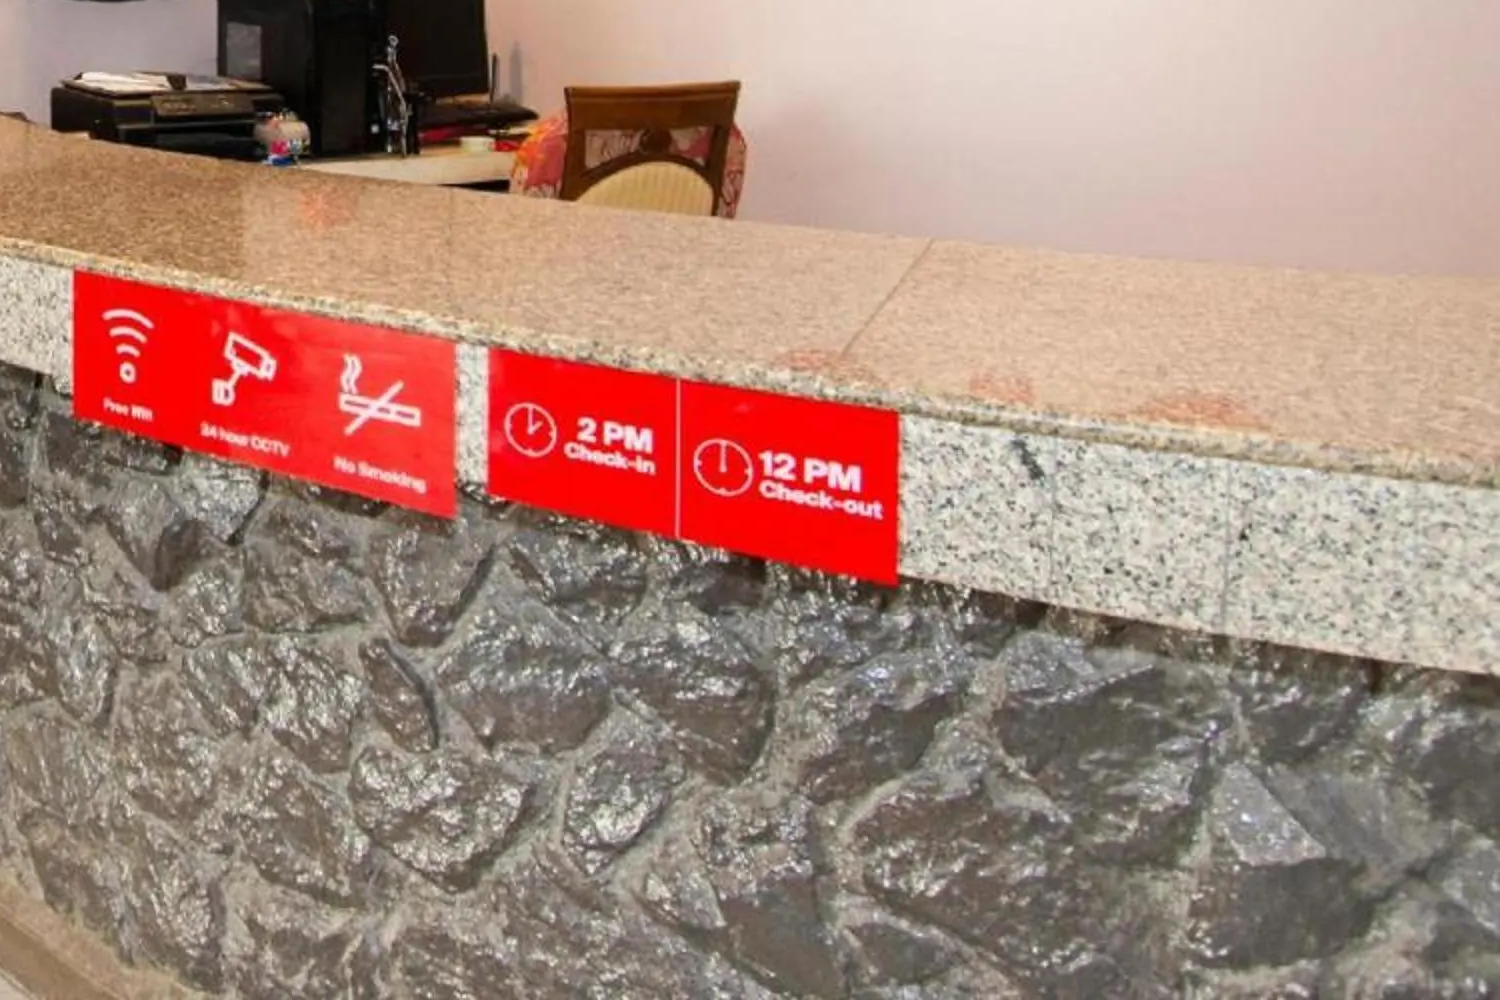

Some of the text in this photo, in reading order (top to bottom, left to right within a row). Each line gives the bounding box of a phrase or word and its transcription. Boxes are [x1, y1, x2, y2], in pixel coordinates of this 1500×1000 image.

[200, 421, 219, 439] 24
[250, 432, 290, 458] CCTV
[576, 417, 654, 453] 2 PM
[333, 456, 427, 495] No Smoking
[564, 442, 656, 476] Check-in
[758, 451, 861, 493] 12 PM
[758, 481, 883, 519] Check-out
